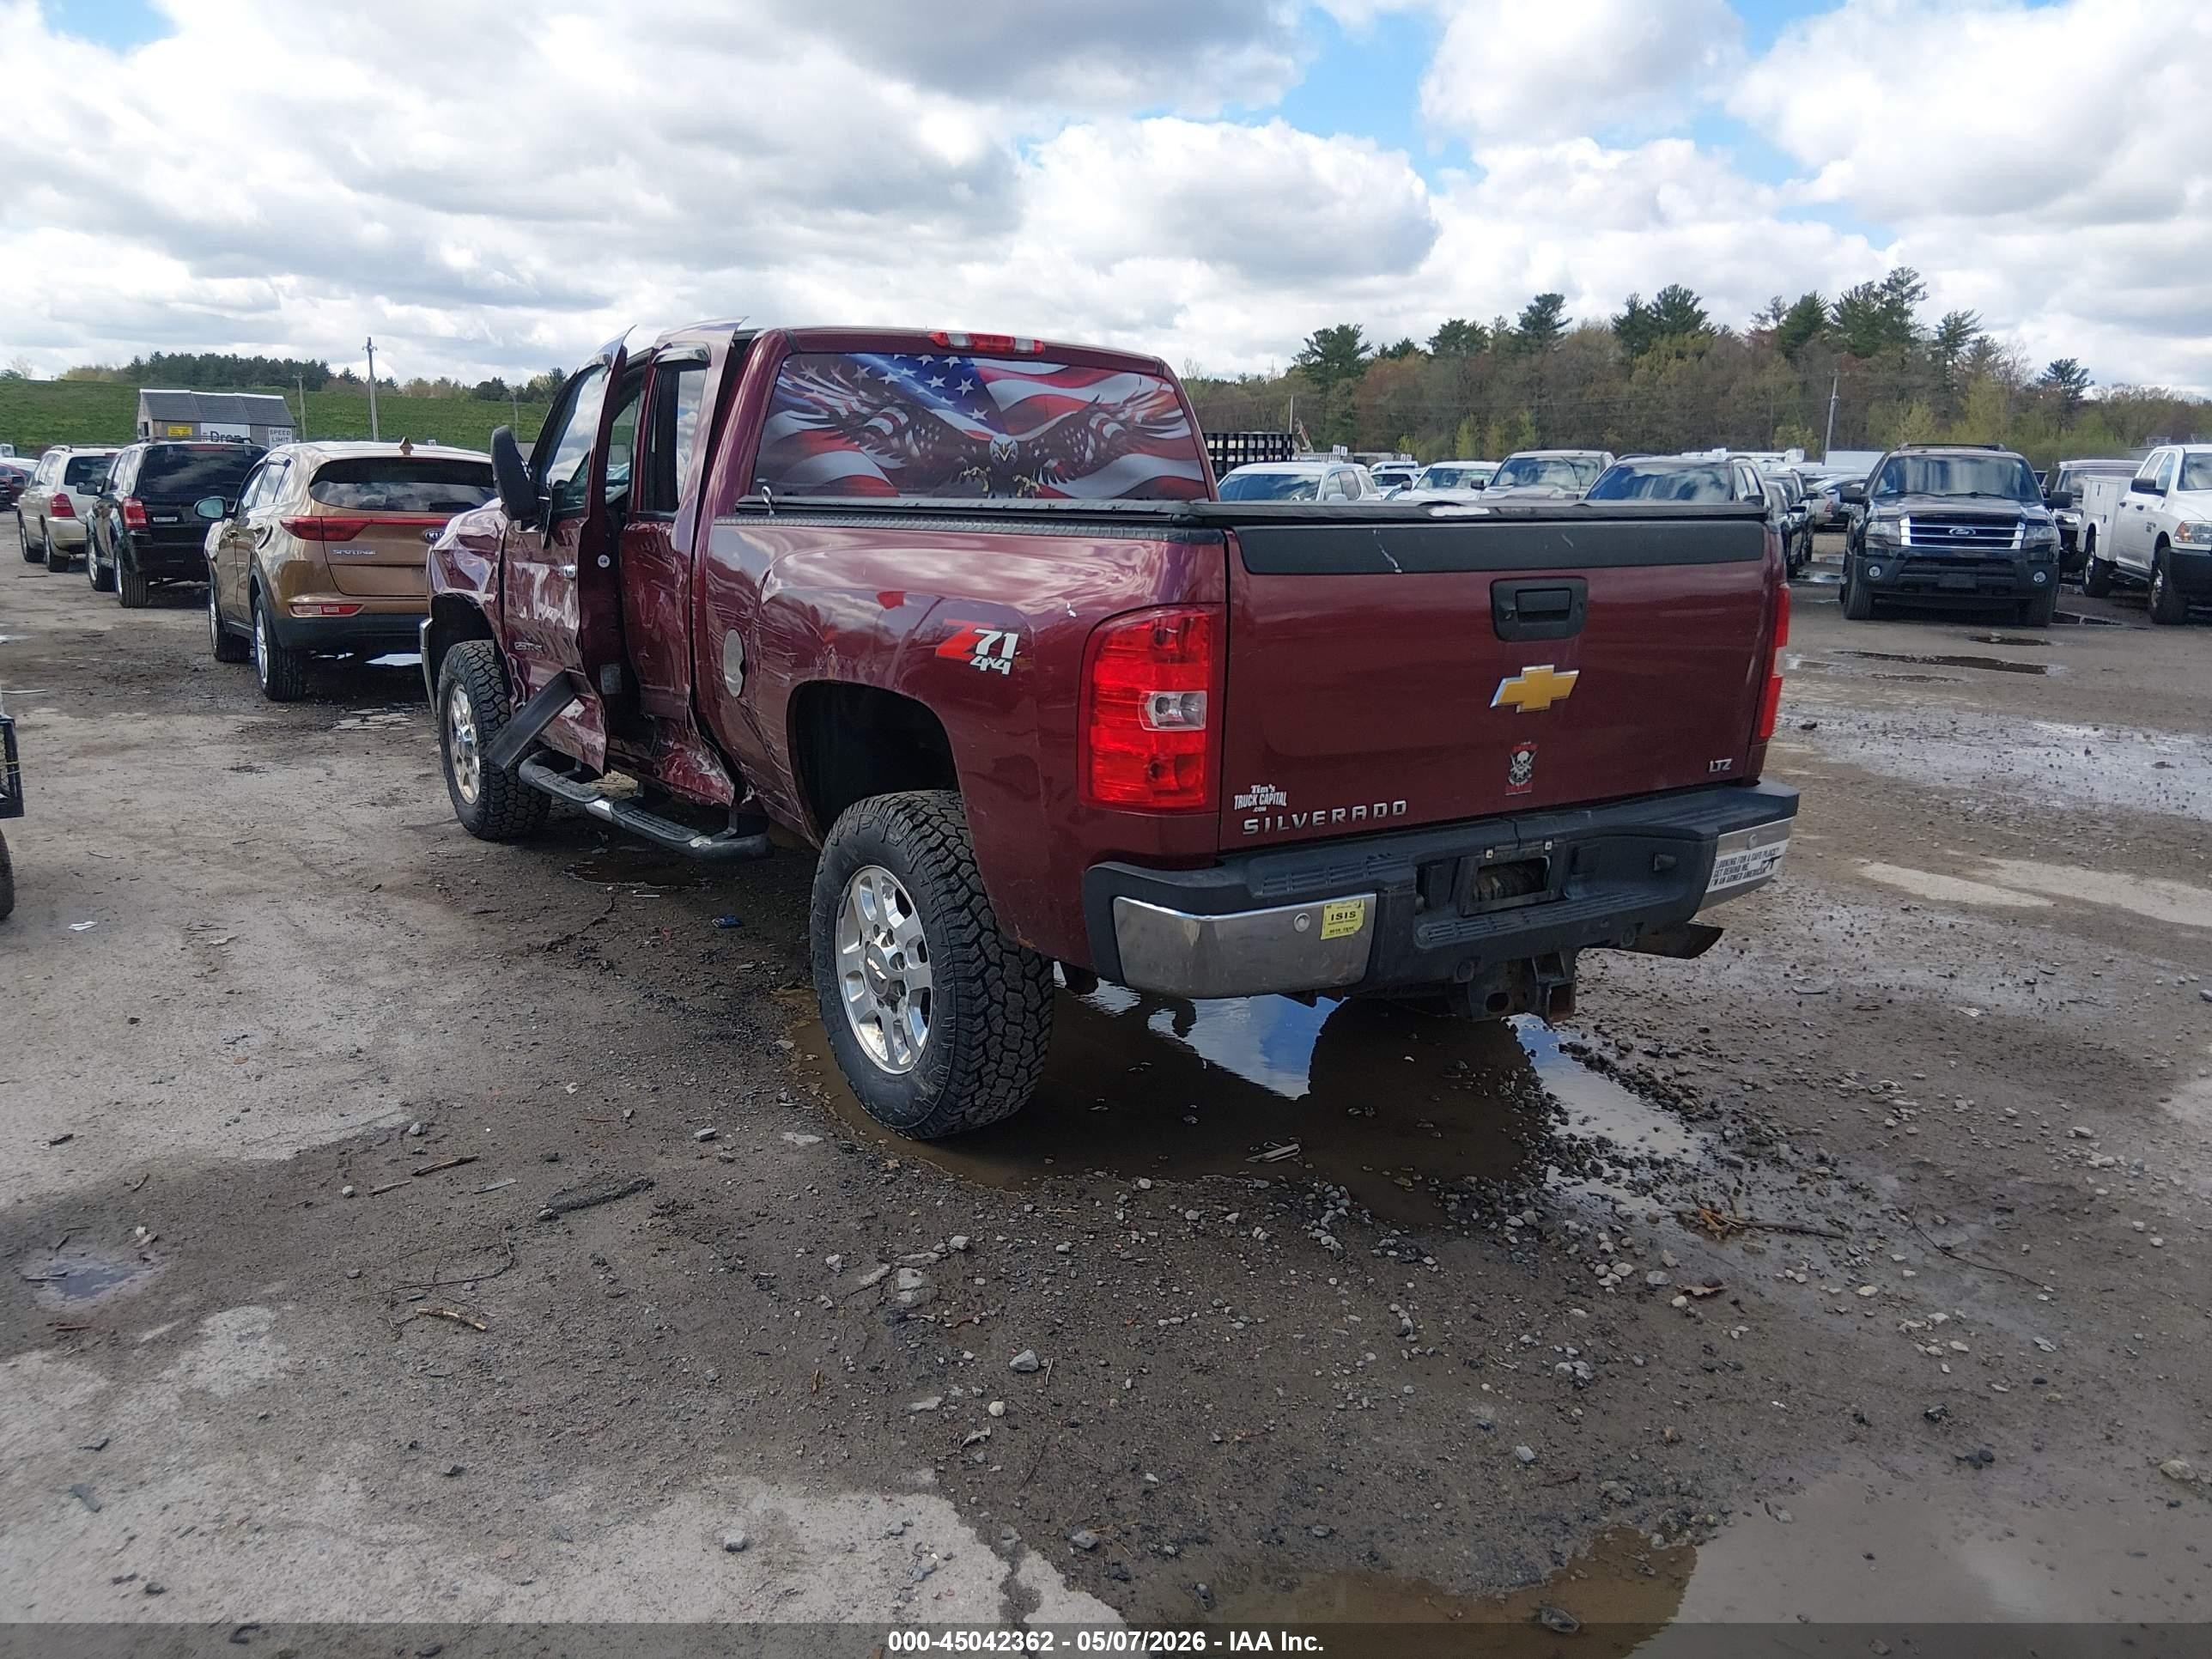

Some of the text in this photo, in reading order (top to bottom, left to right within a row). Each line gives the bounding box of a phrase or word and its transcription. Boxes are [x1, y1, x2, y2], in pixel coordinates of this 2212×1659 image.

[935, 618, 1019, 660] Z71
[1709, 758, 1733, 773] LTZ
[1250, 783, 1276, 794] Tim's
[1234, 791, 1287, 810] TRUCK CAPITAL
[1243, 799, 1407, 836] SILVERADO
[1716, 857, 1737, 868] LOOKING
[1751, 852, 1762, 860] SAFE
[1331, 910, 1357, 921] ISIS
